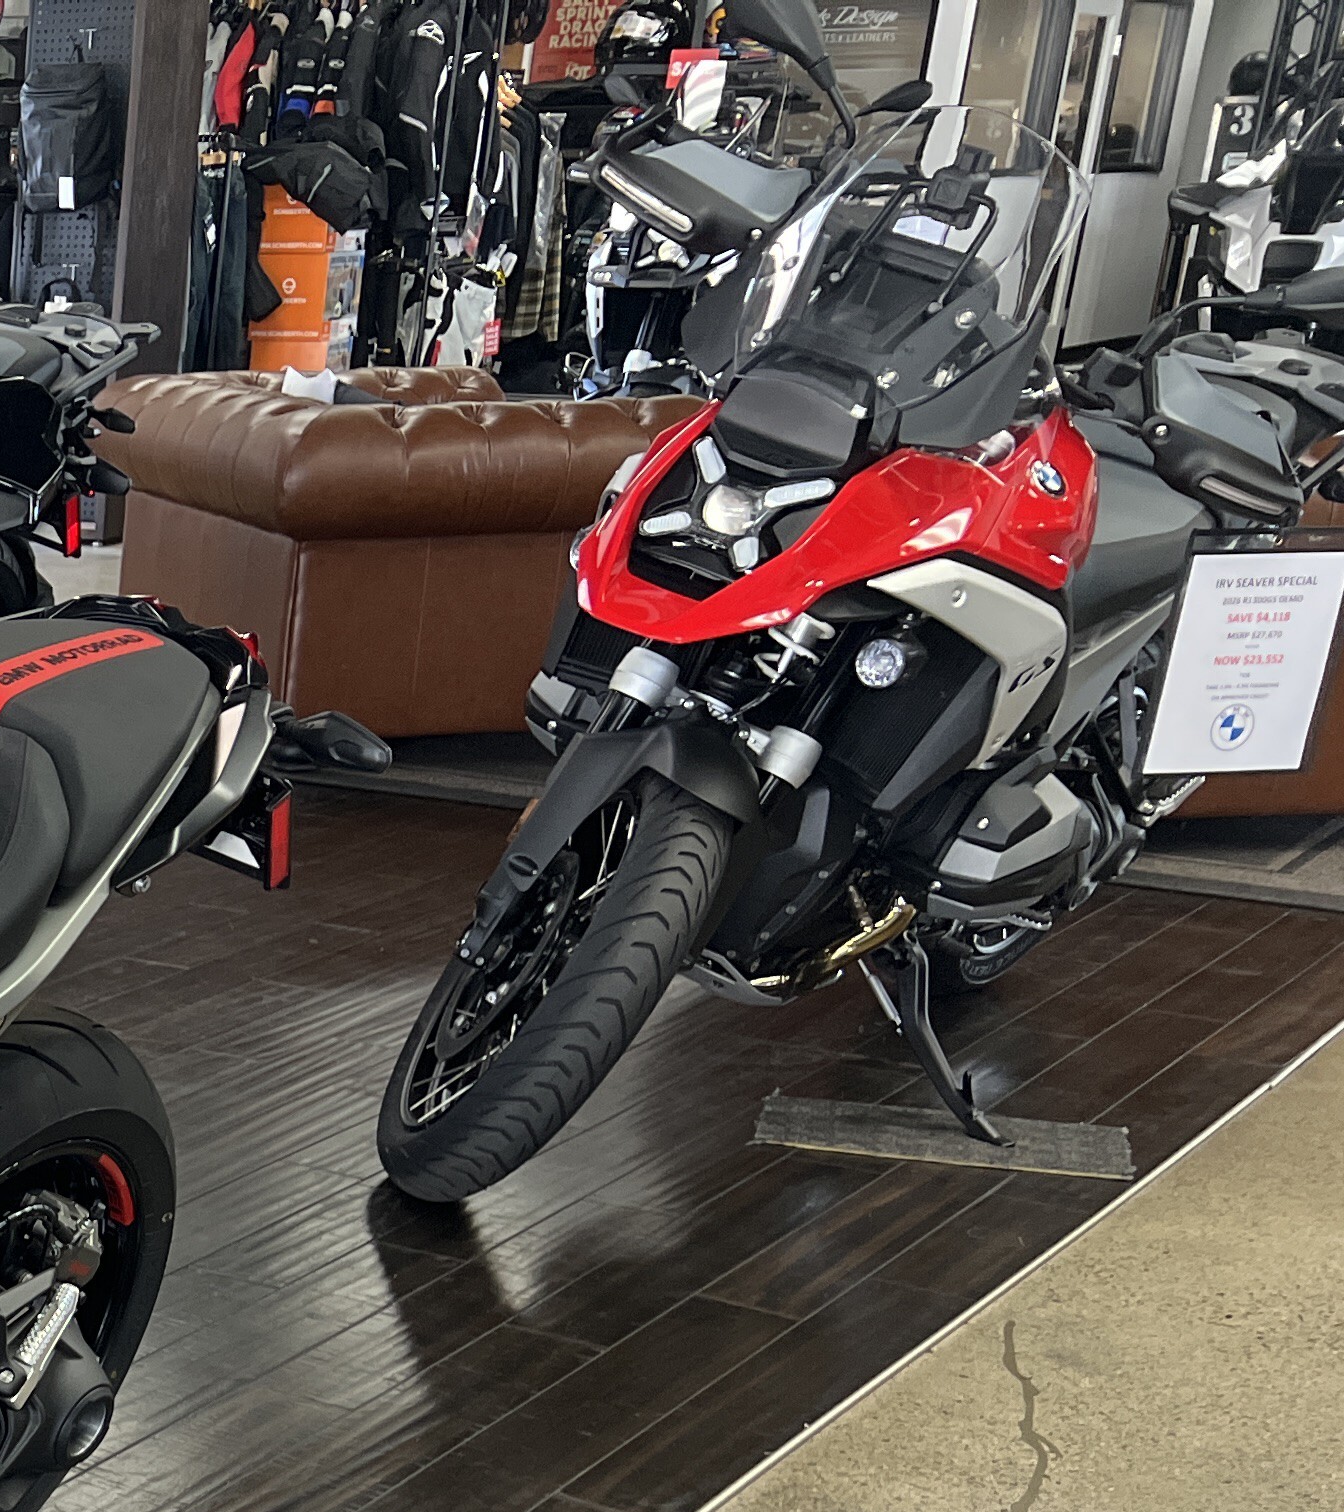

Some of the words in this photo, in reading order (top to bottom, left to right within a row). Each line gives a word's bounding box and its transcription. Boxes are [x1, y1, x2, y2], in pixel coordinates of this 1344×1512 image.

[556, 5, 617, 21] SPRINT
[549, 33, 598, 48] RACIN
[1229, 104, 1255, 136] 3
[1216, 578, 1234, 589] IRV
[1236, 577, 1275, 588] SEAVER
[1278, 575, 1318, 586] SPECIAL
[1227, 613, 1253, 624] SAVE
[40, 633, 144, 667] MOTORRAD
[1214, 655, 1241, 666] NOW
